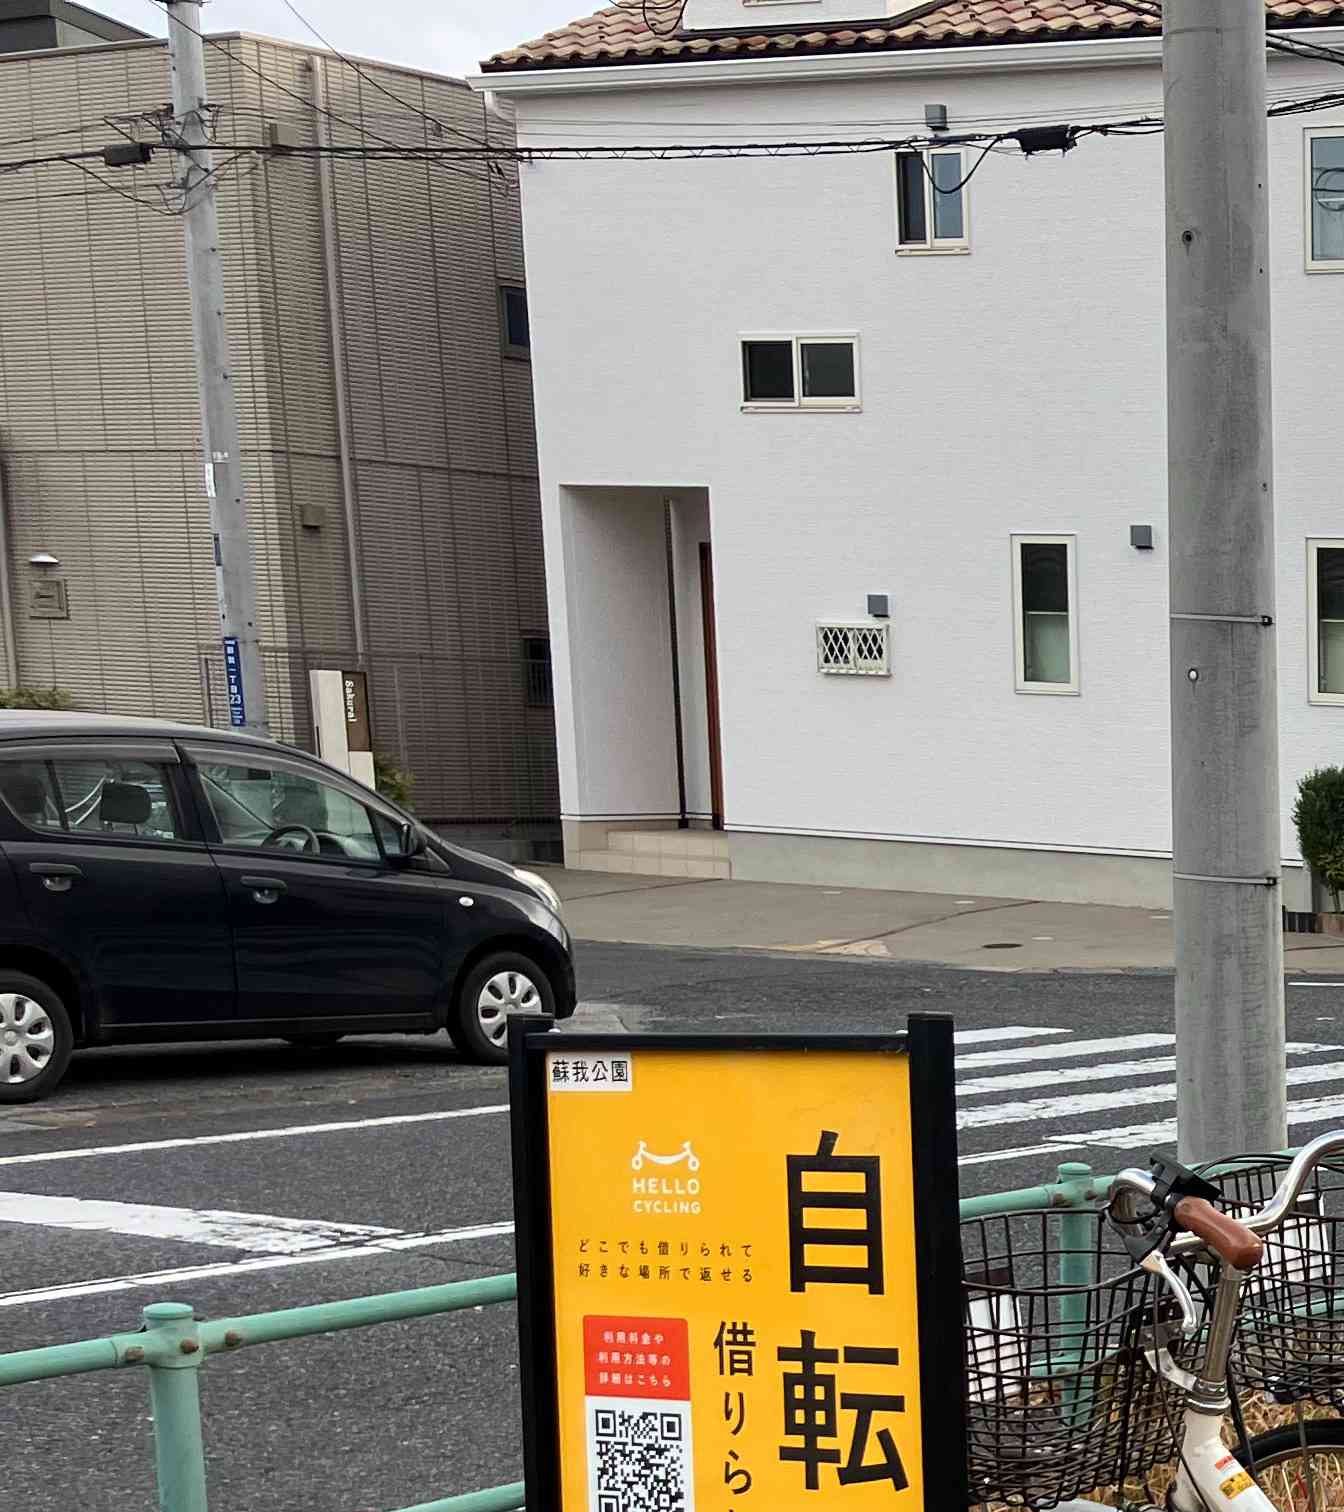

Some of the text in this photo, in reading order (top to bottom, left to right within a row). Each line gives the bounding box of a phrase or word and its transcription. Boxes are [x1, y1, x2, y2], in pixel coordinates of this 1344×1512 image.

[552, 1060, 629, 1083] 蘇我公園
[632, 1178, 700, 1195] HELLO
[633, 1200, 701, 1214] CYCLING
[579, 1239, 753, 1258] どこでも借りられて
[579, 1263, 753, 1283] 好きな場所で返せる
